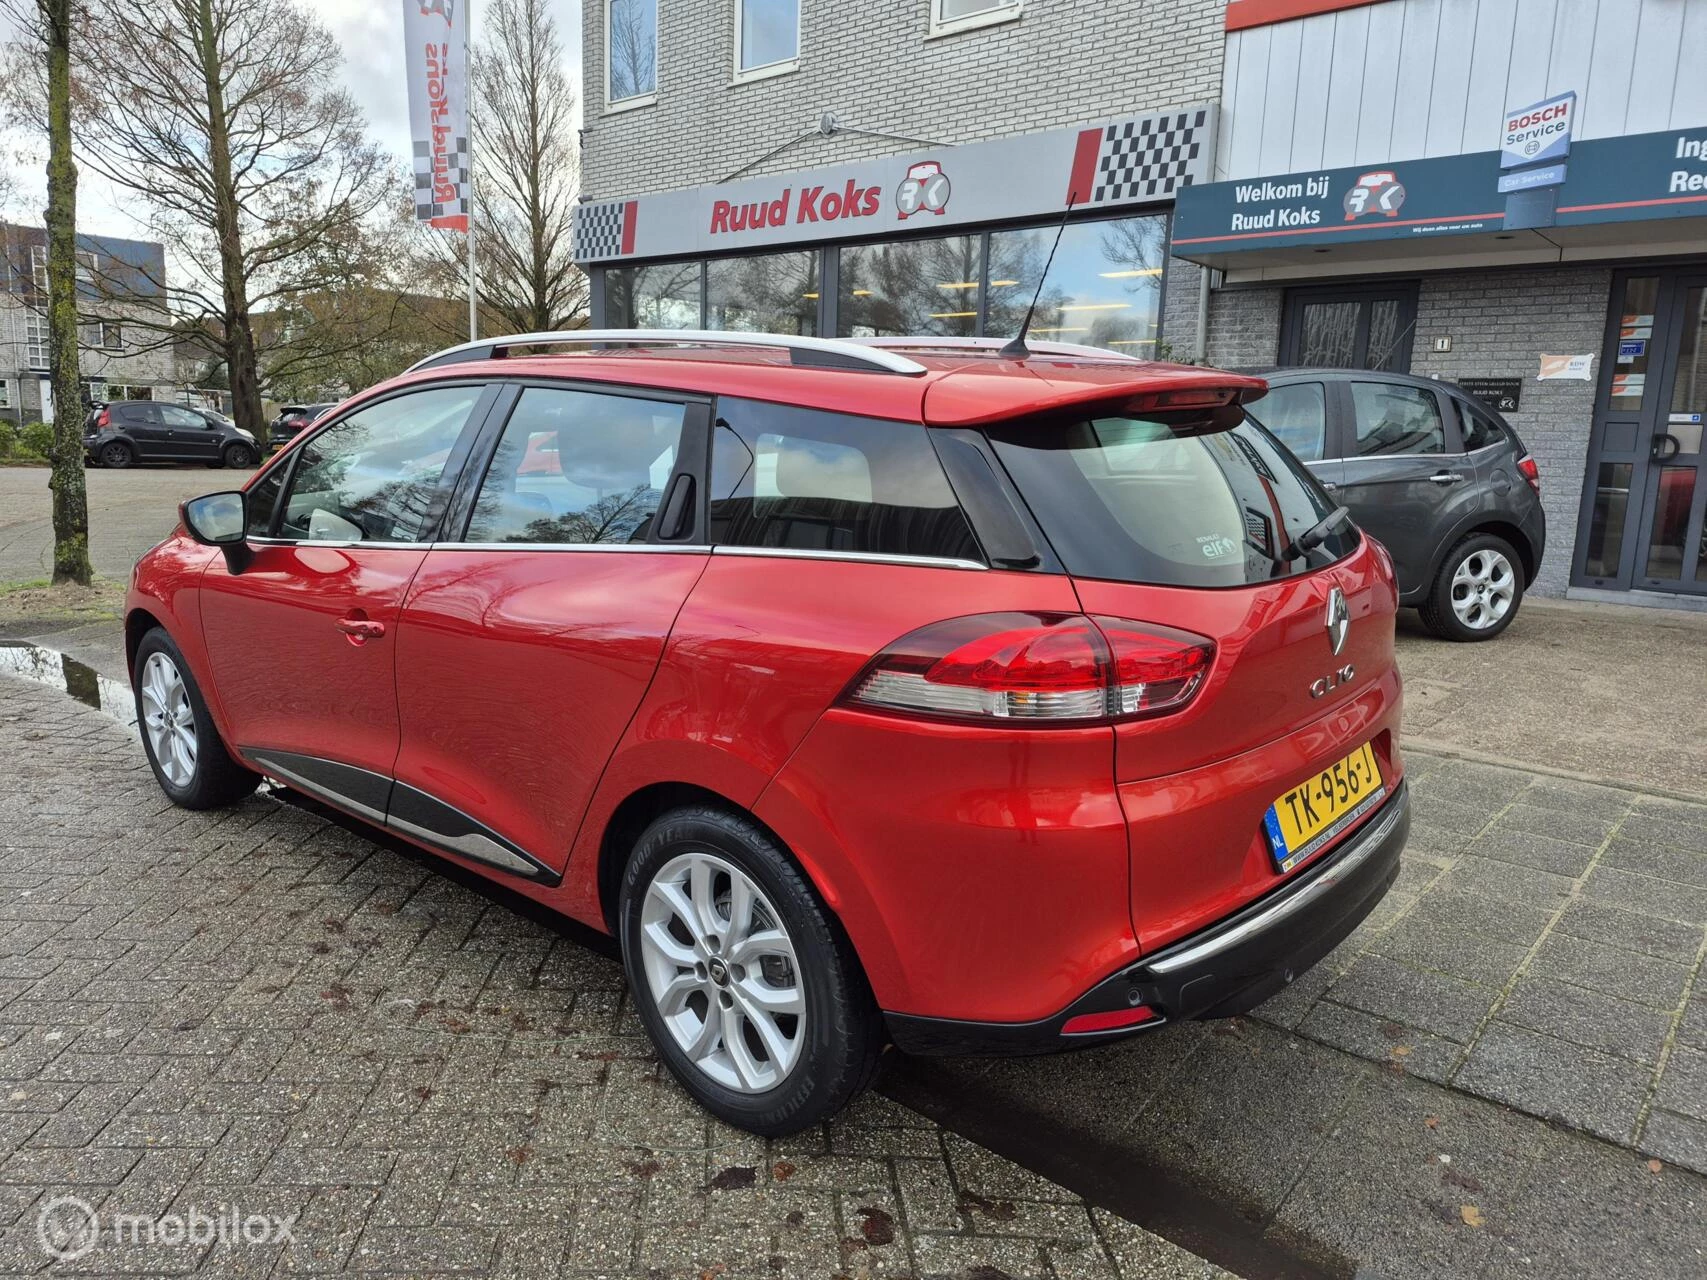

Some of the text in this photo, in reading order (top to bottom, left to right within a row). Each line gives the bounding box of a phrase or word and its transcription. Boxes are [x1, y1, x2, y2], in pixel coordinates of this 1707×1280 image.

[1508, 102, 1568, 132] BOSCH
[1506, 121, 1566, 145] Service
[1235, 176, 1330, 204] Welkom bij
[1522, 171, 1555, 183] Service
[710, 178, 882, 234] Ruud Koks
[1231, 206, 1321, 231] Ruud Koks
[1310, 663, 1355, 699] CLIO
[1285, 745, 1372, 835] TK-956-J
[1272, 834, 1284, 850] NL
